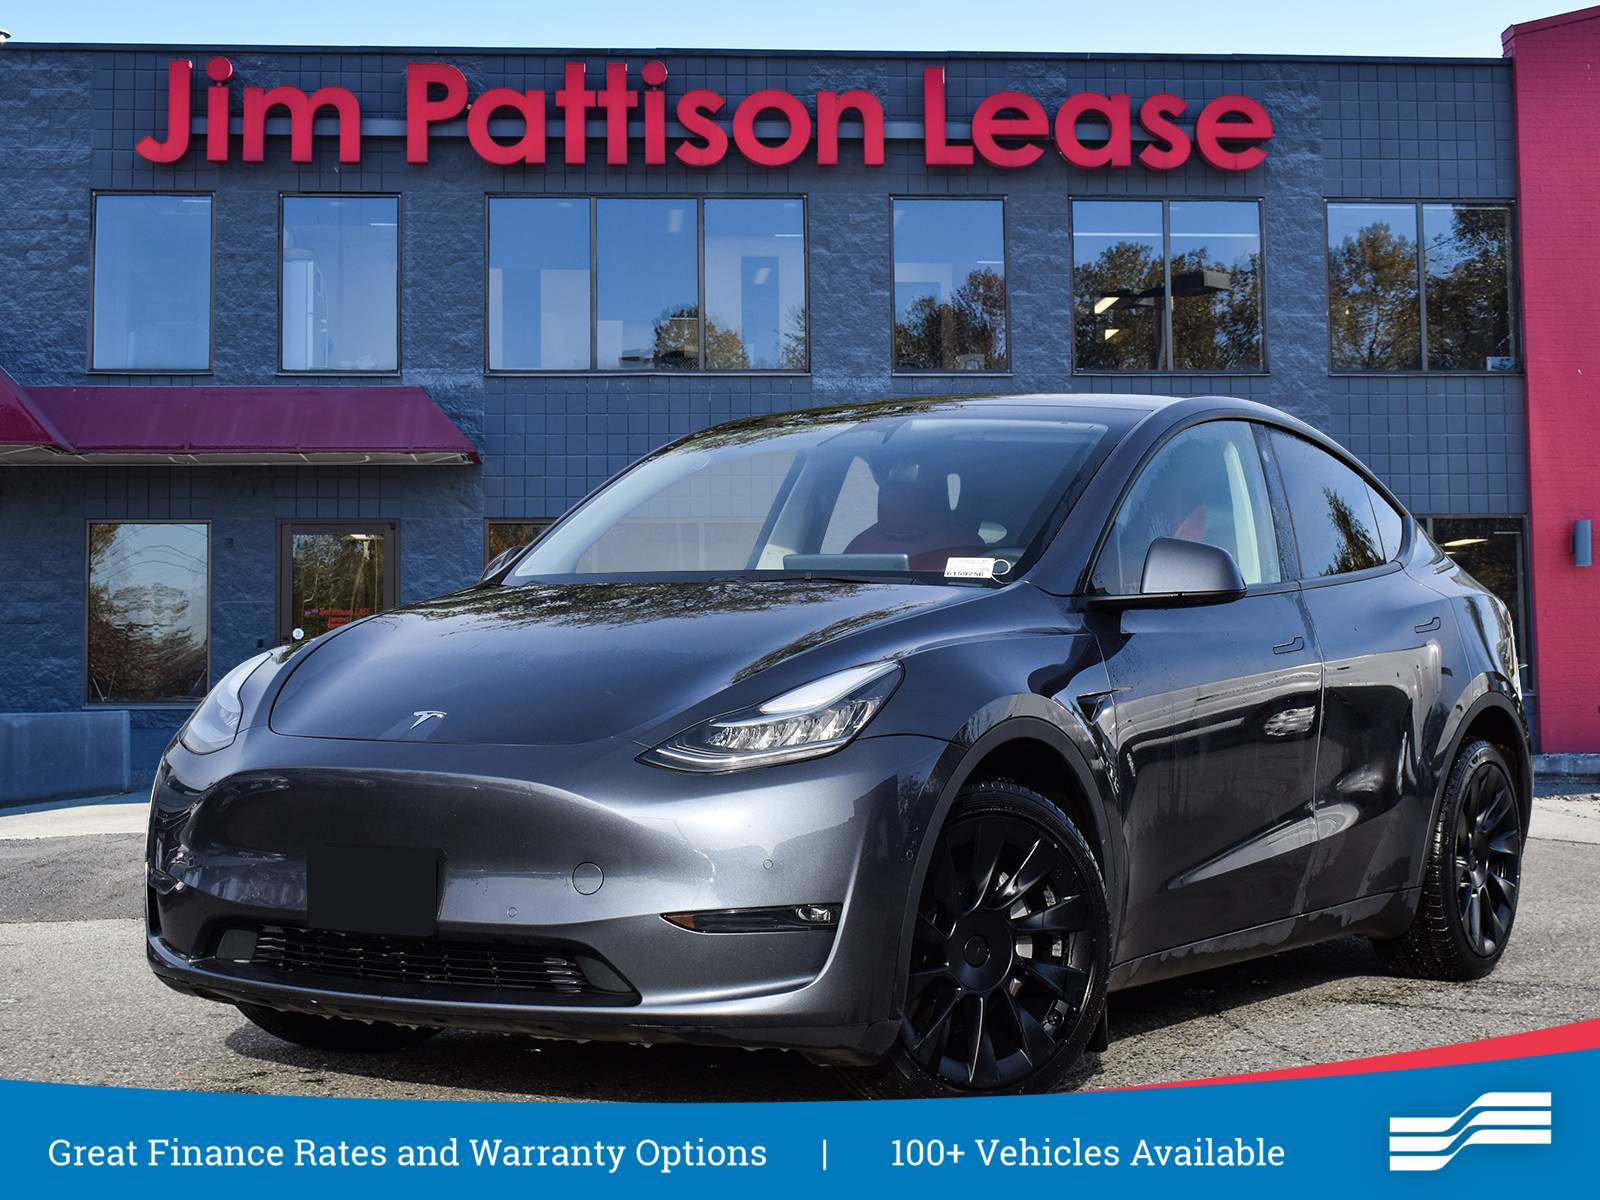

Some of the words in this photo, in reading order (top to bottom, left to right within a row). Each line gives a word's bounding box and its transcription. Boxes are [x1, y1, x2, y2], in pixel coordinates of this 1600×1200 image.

[134, 57, 361, 163] Jim
[407, 61, 885, 166] Pattison
[924, 66, 1274, 171] Lease
